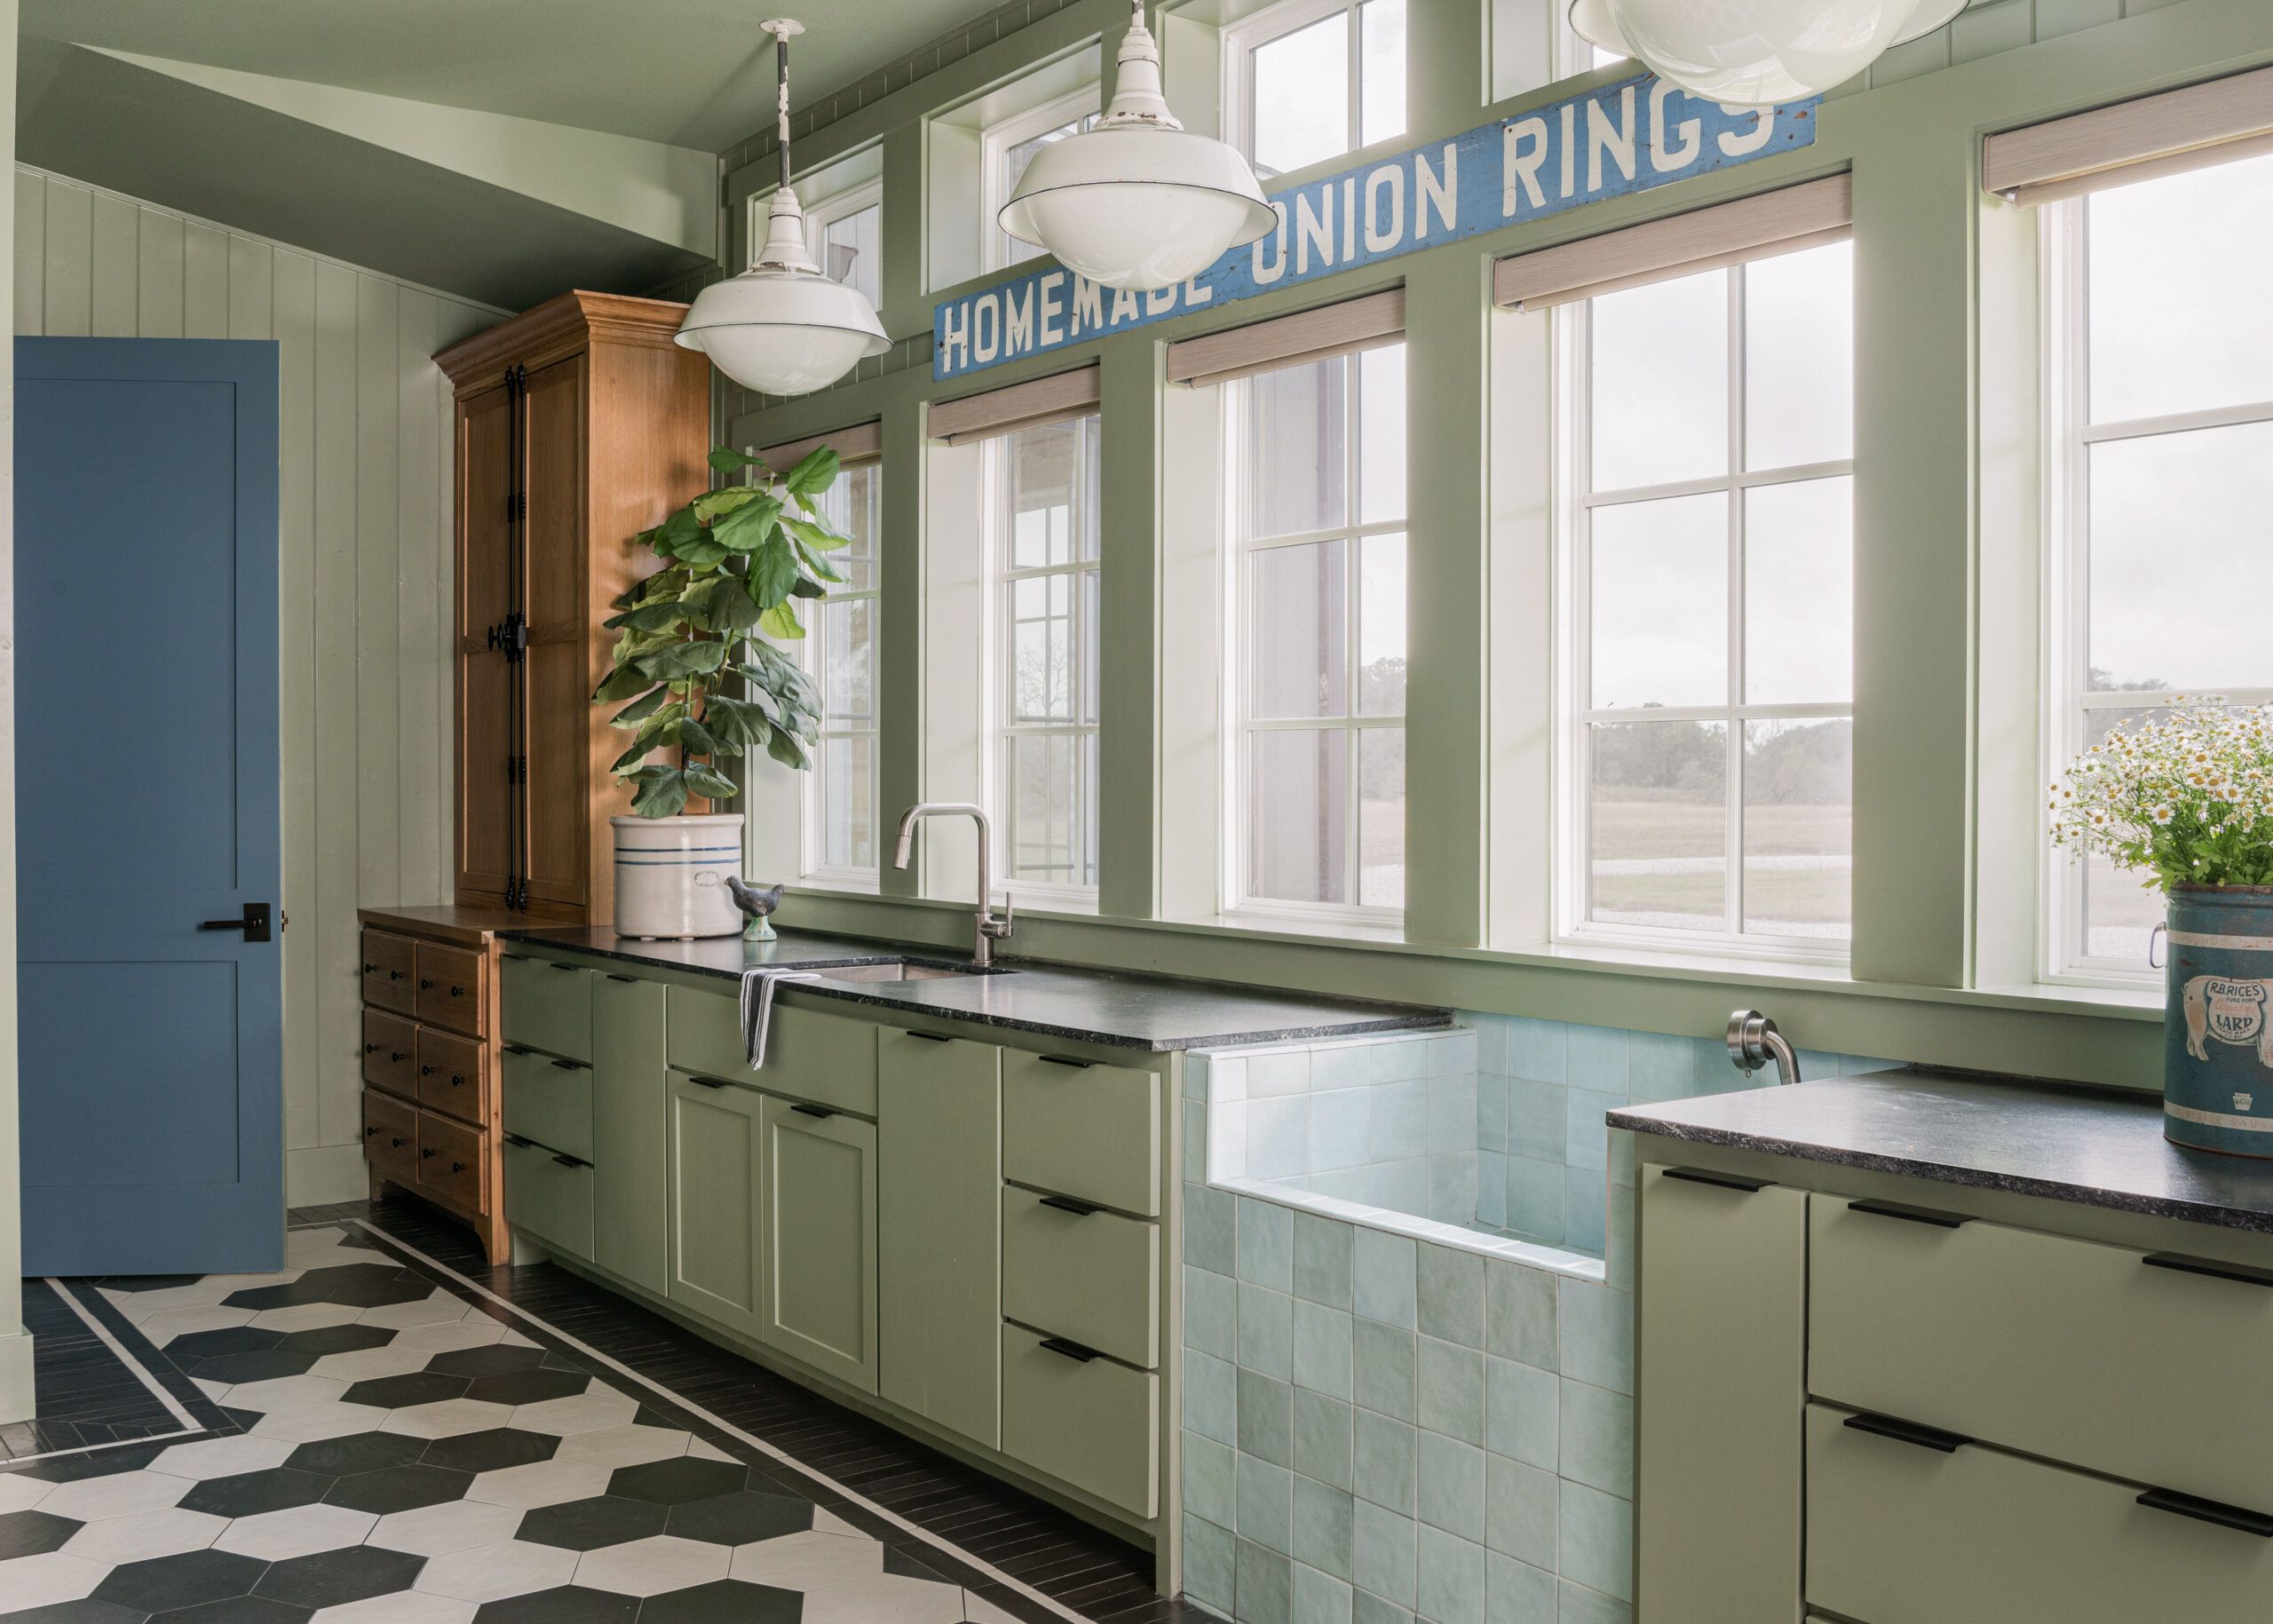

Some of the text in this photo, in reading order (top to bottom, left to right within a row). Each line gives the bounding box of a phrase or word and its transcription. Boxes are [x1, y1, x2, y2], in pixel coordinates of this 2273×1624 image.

[1252, 142, 1458, 285] ONION
[1502, 76, 1774, 218] RINGS
[2216, 1014, 2253, 1031] LARD
